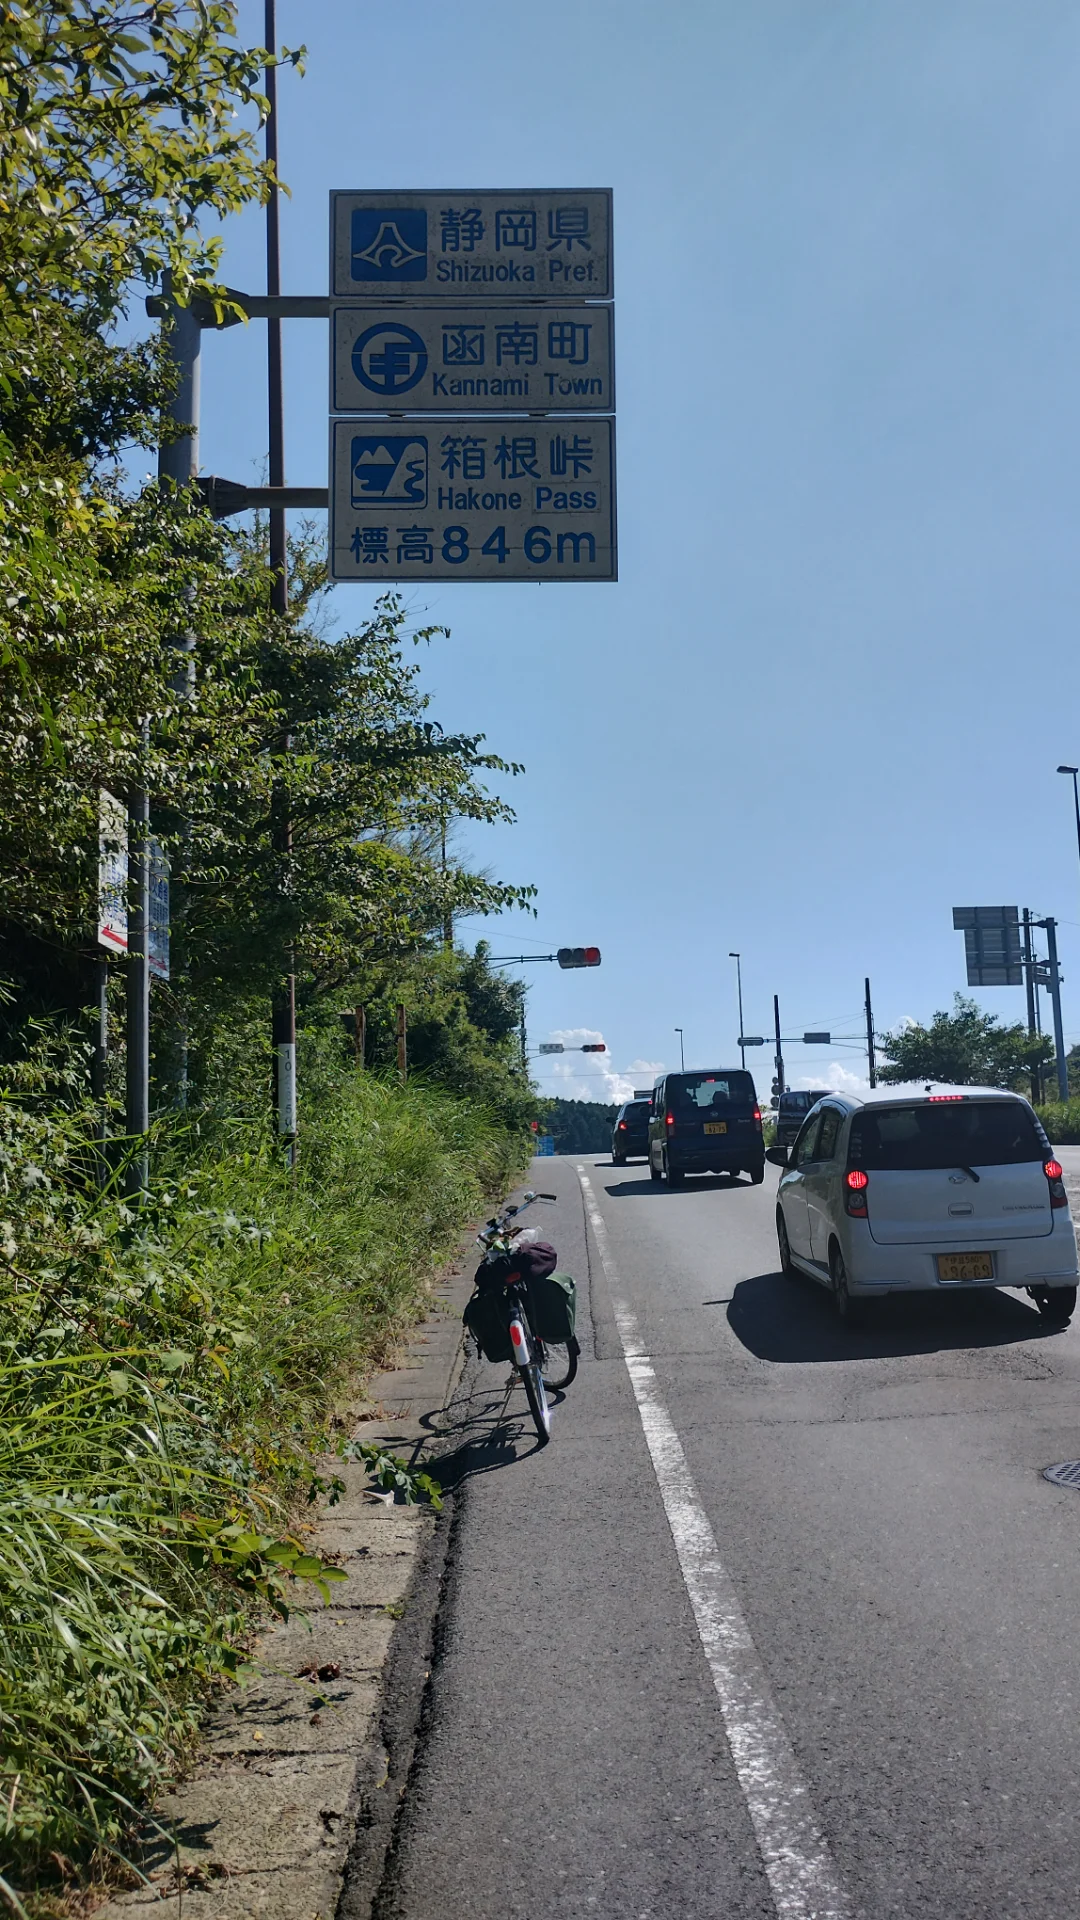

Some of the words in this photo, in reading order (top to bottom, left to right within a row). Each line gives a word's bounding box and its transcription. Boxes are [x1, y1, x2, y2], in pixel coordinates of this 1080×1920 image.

[440, 208, 591, 252] 静岡県
[436, 260, 535, 282] Shizuoka
[549, 260, 598, 282] Pref.
[441, 321, 593, 366] 函南町
[433, 373, 529, 396] Kannami
[544, 373, 603, 396] Town
[440, 435, 594, 480] 箱根峠
[438, 487, 522, 510] Hakone
[536, 487, 597, 510] Pass
